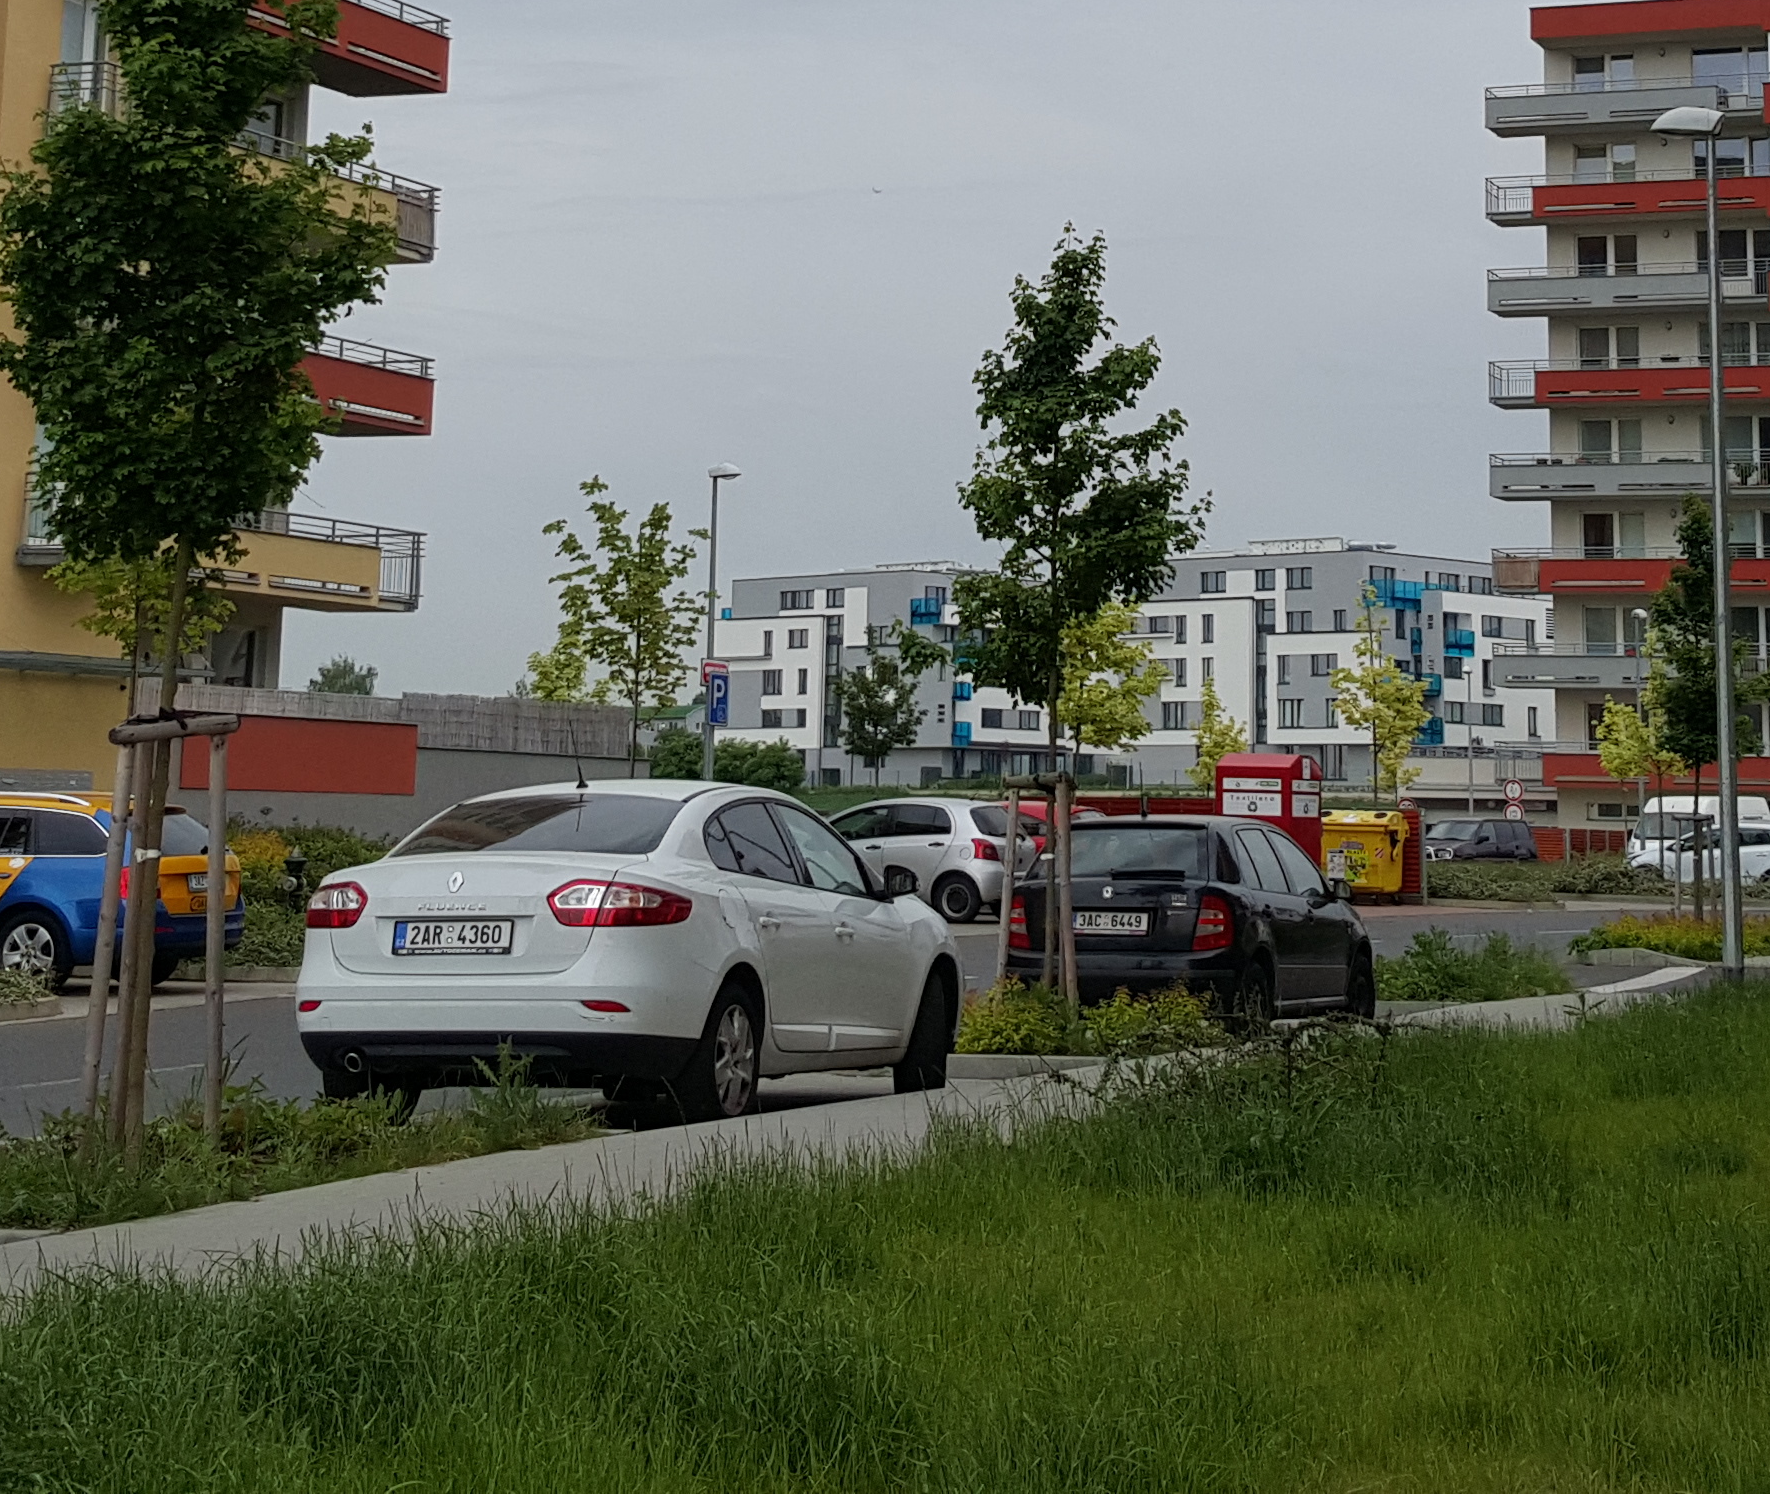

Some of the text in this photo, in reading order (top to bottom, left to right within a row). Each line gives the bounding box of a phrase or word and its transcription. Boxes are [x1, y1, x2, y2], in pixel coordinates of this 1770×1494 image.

[713, 679, 725, 709] P
[1079, 914, 1142, 928] 3AC 6449
[410, 924, 502, 945] 2AR 4360
